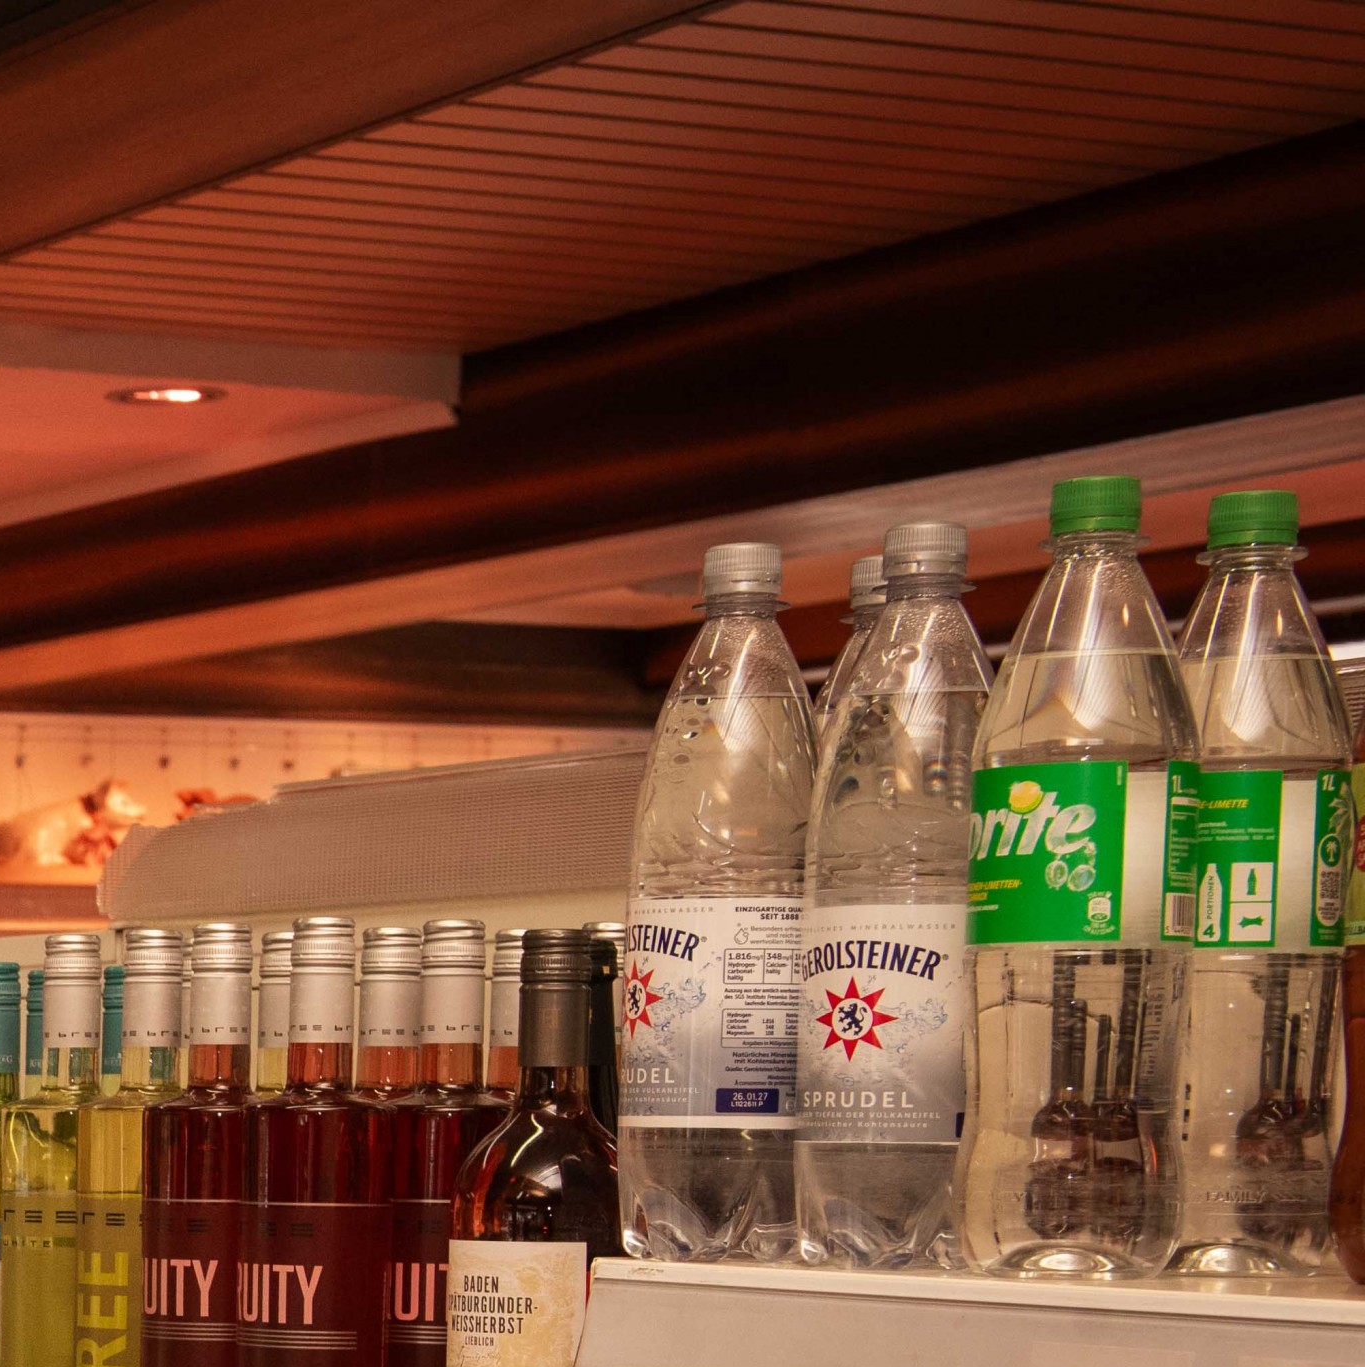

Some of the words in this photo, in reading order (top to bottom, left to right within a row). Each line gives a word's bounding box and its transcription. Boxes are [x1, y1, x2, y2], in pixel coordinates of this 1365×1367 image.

[1322, 774, 1336, 791] 1L
[1206, 875, 1215, 920] PORTIONEN
[1203, 923, 1215, 938] 4
[802, 940, 942, 982] GEROLSTEINER
[803, 1091, 915, 1109] SPRUDEL
[857, 1120, 929, 1129] Kohlensäure
[463, 1275, 500, 1294] BADEN
[451, 1317, 525, 1335] WEISSHERBST
[464, 1336, 495, 1347] LIEBLICH
